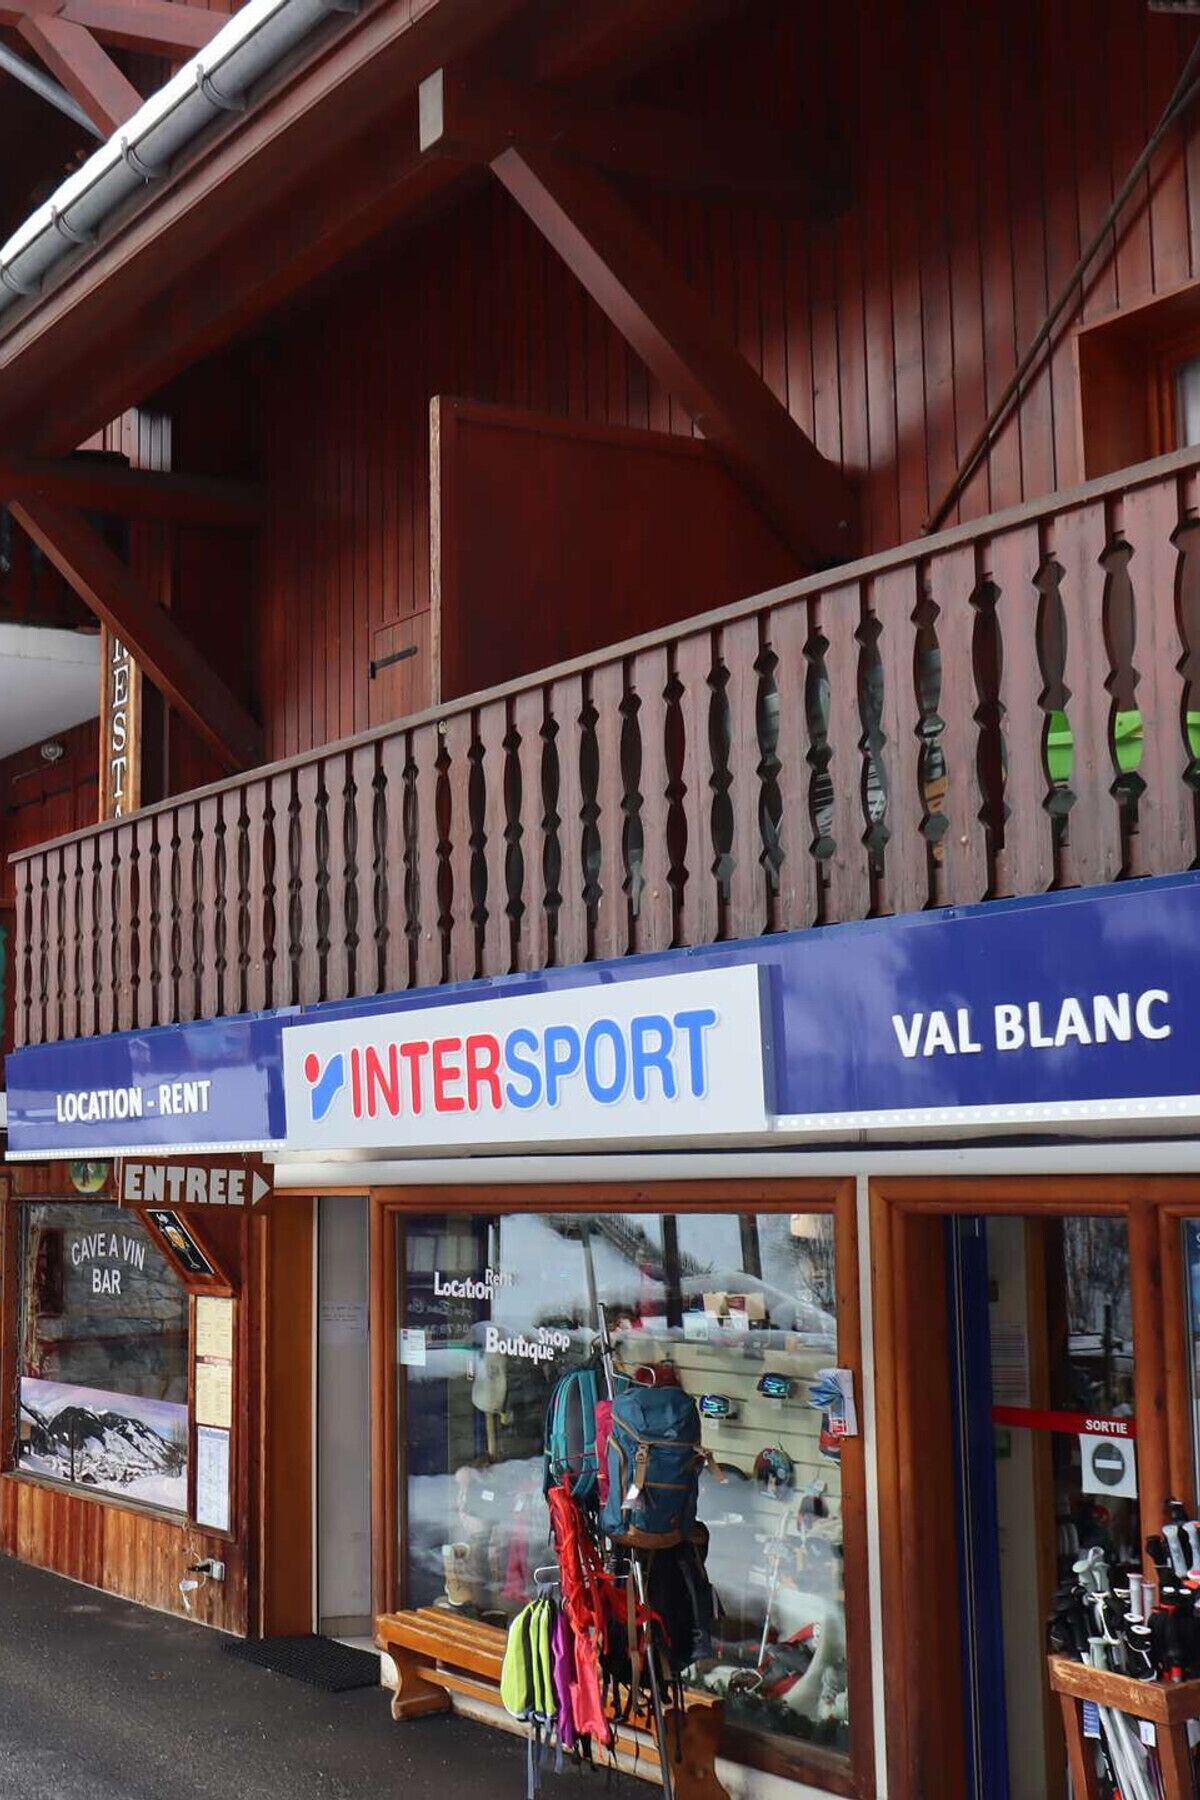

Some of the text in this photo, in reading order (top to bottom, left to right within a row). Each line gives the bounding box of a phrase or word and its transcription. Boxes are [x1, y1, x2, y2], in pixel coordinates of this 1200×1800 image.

[892, 989, 1171, 1058] VAL BLANC
[350, 1008, 718, 1119] INTERSPORT
[57, 1087, 143, 1122] LOCATION
[159, 1080, 211, 1115] RENT
[125, 1163, 246, 1206] ENTREE
[72, 1232, 145, 1271] CAVE A VIN
[92, 1268, 121, 1294] BAR
[434, 1271, 494, 1300] Location
[485, 1327, 555, 1365] Boutique
[538, 1327, 570, 1352] Shop
[1085, 1419, 1128, 1434] SORTIE
